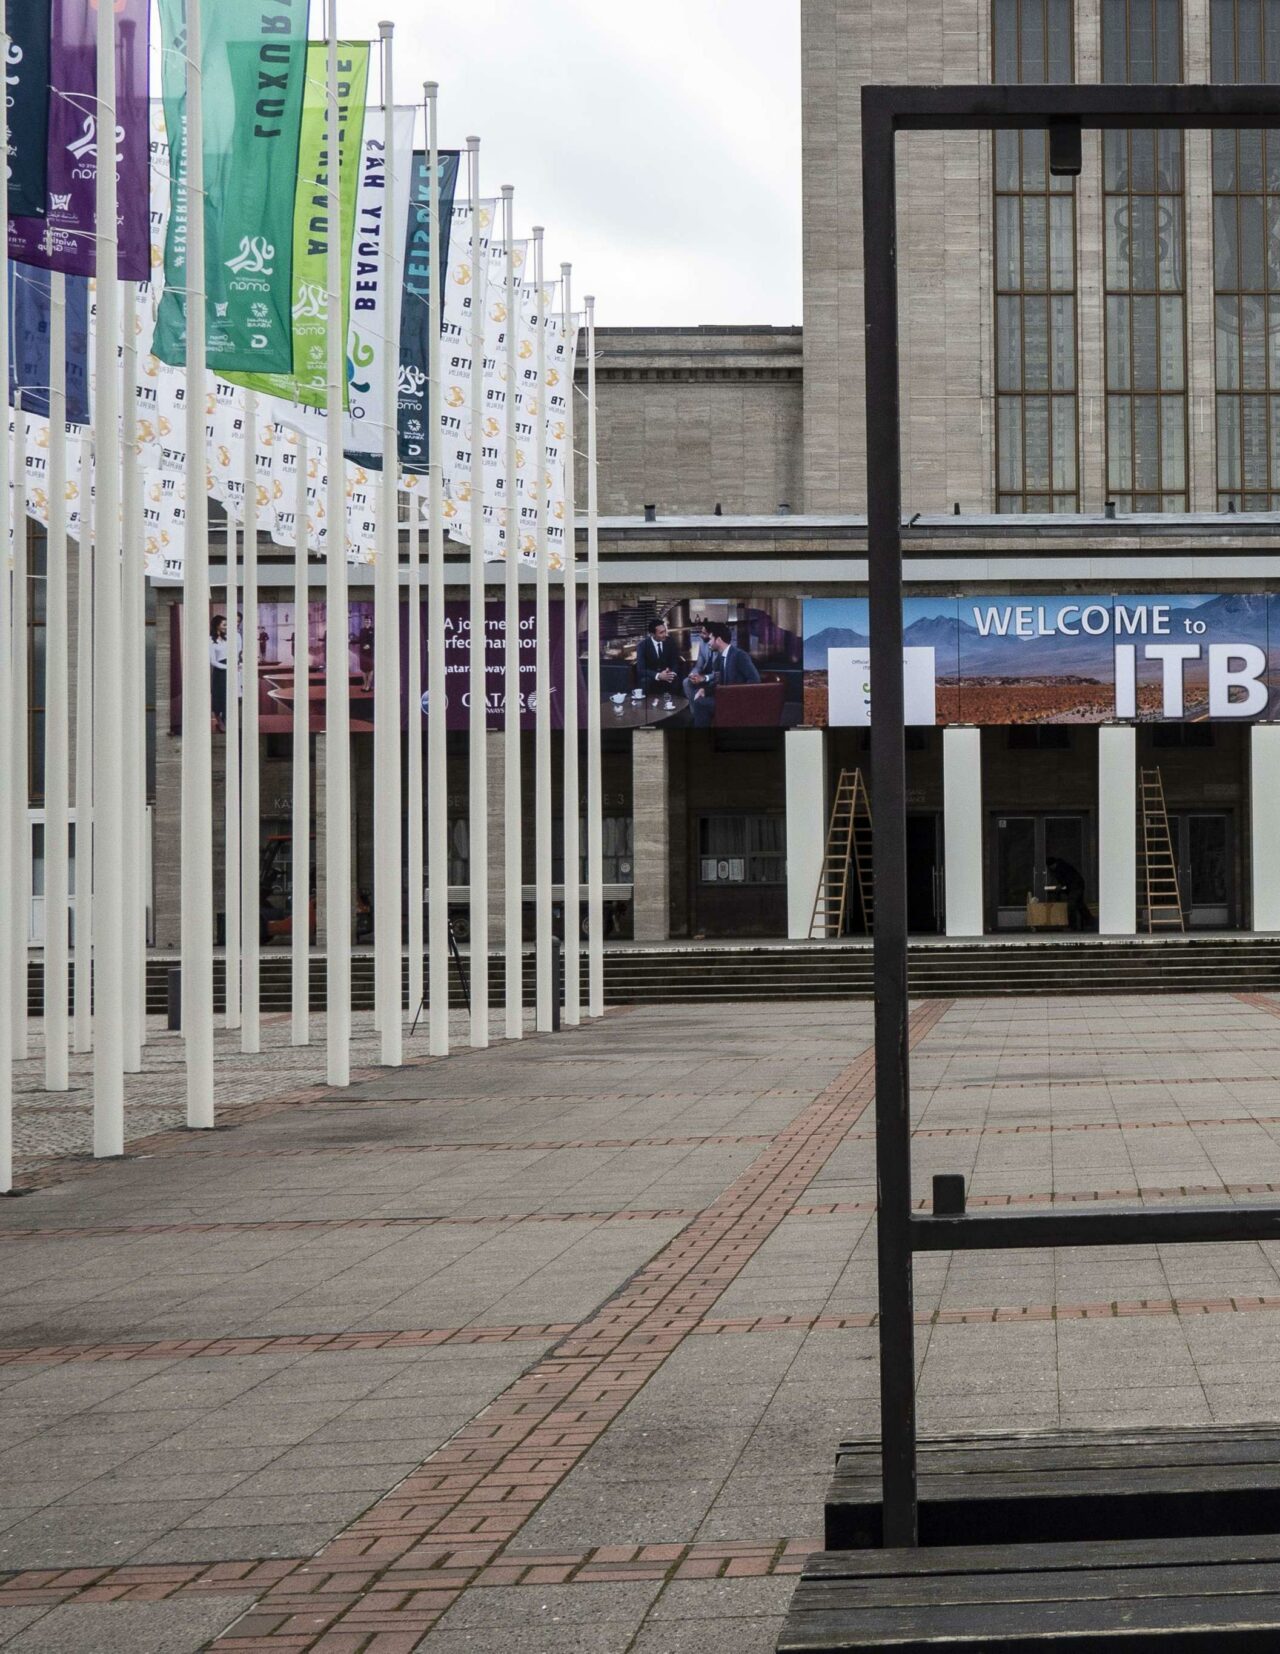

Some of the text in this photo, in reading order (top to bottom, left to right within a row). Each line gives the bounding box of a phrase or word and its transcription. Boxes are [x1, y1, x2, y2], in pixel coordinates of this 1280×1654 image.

[443, 616, 536, 633] A jorne of
[973, 604, 1207, 637] WELCOME to
[1115, 643, 1270, 718] ITB
